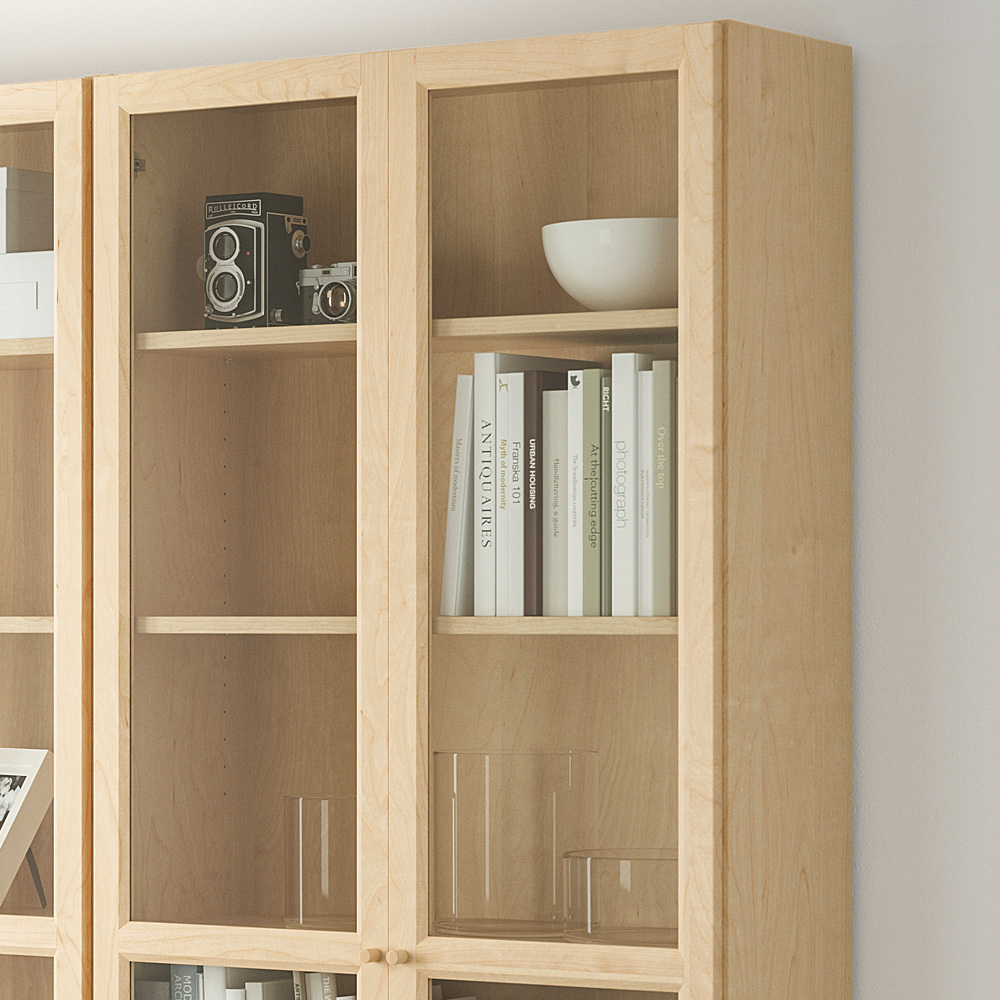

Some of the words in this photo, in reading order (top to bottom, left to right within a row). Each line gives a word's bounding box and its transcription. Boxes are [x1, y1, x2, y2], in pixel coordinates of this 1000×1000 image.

[208, 202, 258, 213] ROLLEICORD
[657, 427, 666, 451] Over
[590, 444, 600, 456] At
[512, 441, 521, 482] Franska
[590, 460, 600, 477] the
[657, 454, 667, 470] the
[479, 420, 492, 548] ANTIQUAIRES
[614, 440, 628, 528] photograph
[656, 473, 664, 489] top
[512, 487, 520, 504] 101
[588, 480, 599, 517] cutting
[589, 520, 600, 548] edge
